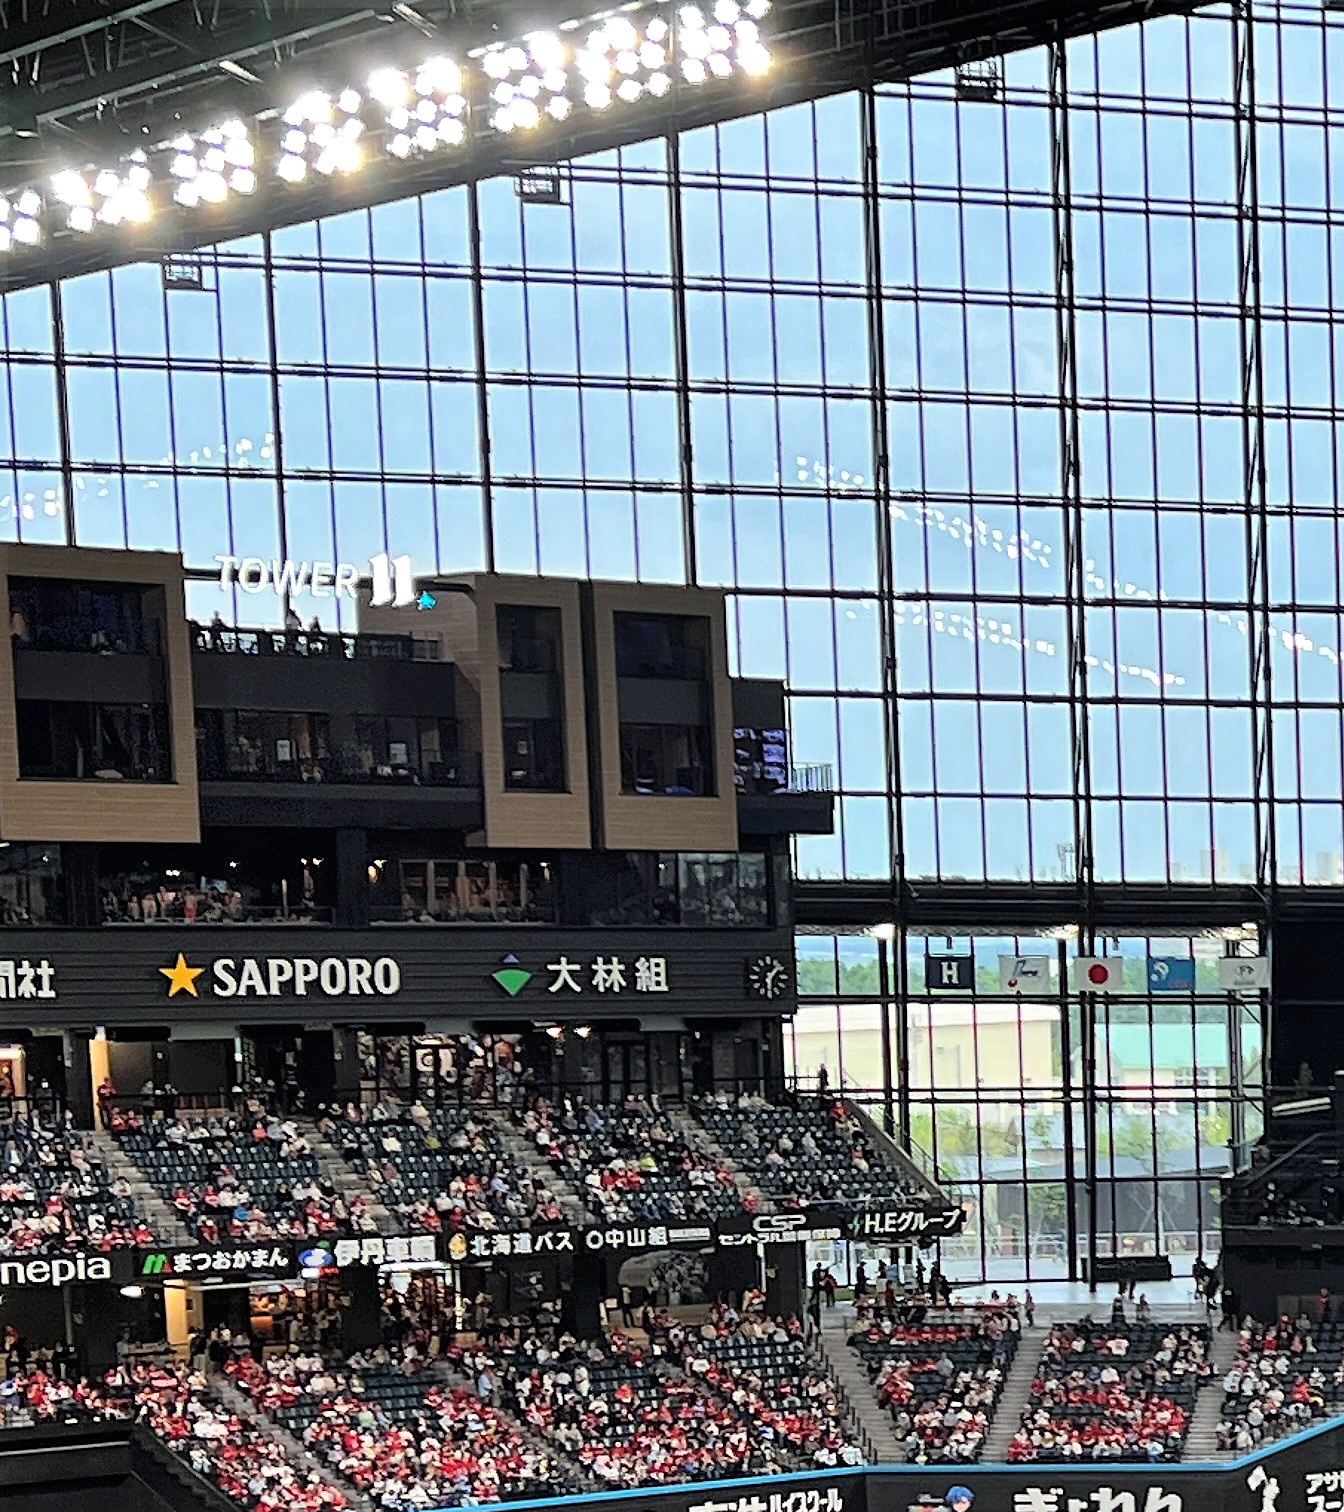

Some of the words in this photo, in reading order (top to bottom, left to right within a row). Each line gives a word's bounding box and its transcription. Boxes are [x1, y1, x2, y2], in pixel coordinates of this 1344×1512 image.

[214, 554, 360, 599] TOWER
[368, 552, 417, 607] 11
[212, 957, 400, 998] SAPPORO
[546, 956, 670, 994] 大林組
[940, 961, 961, 985] H
[752, 1214, 807, 1234] CSP
[470, 1231, 574, 1256] 北海道バス
[605, 1226, 668, 1248] 中山組
[0, 1253, 112, 1287] nepia
[172, 1250, 289, 1274] まつおかまん
